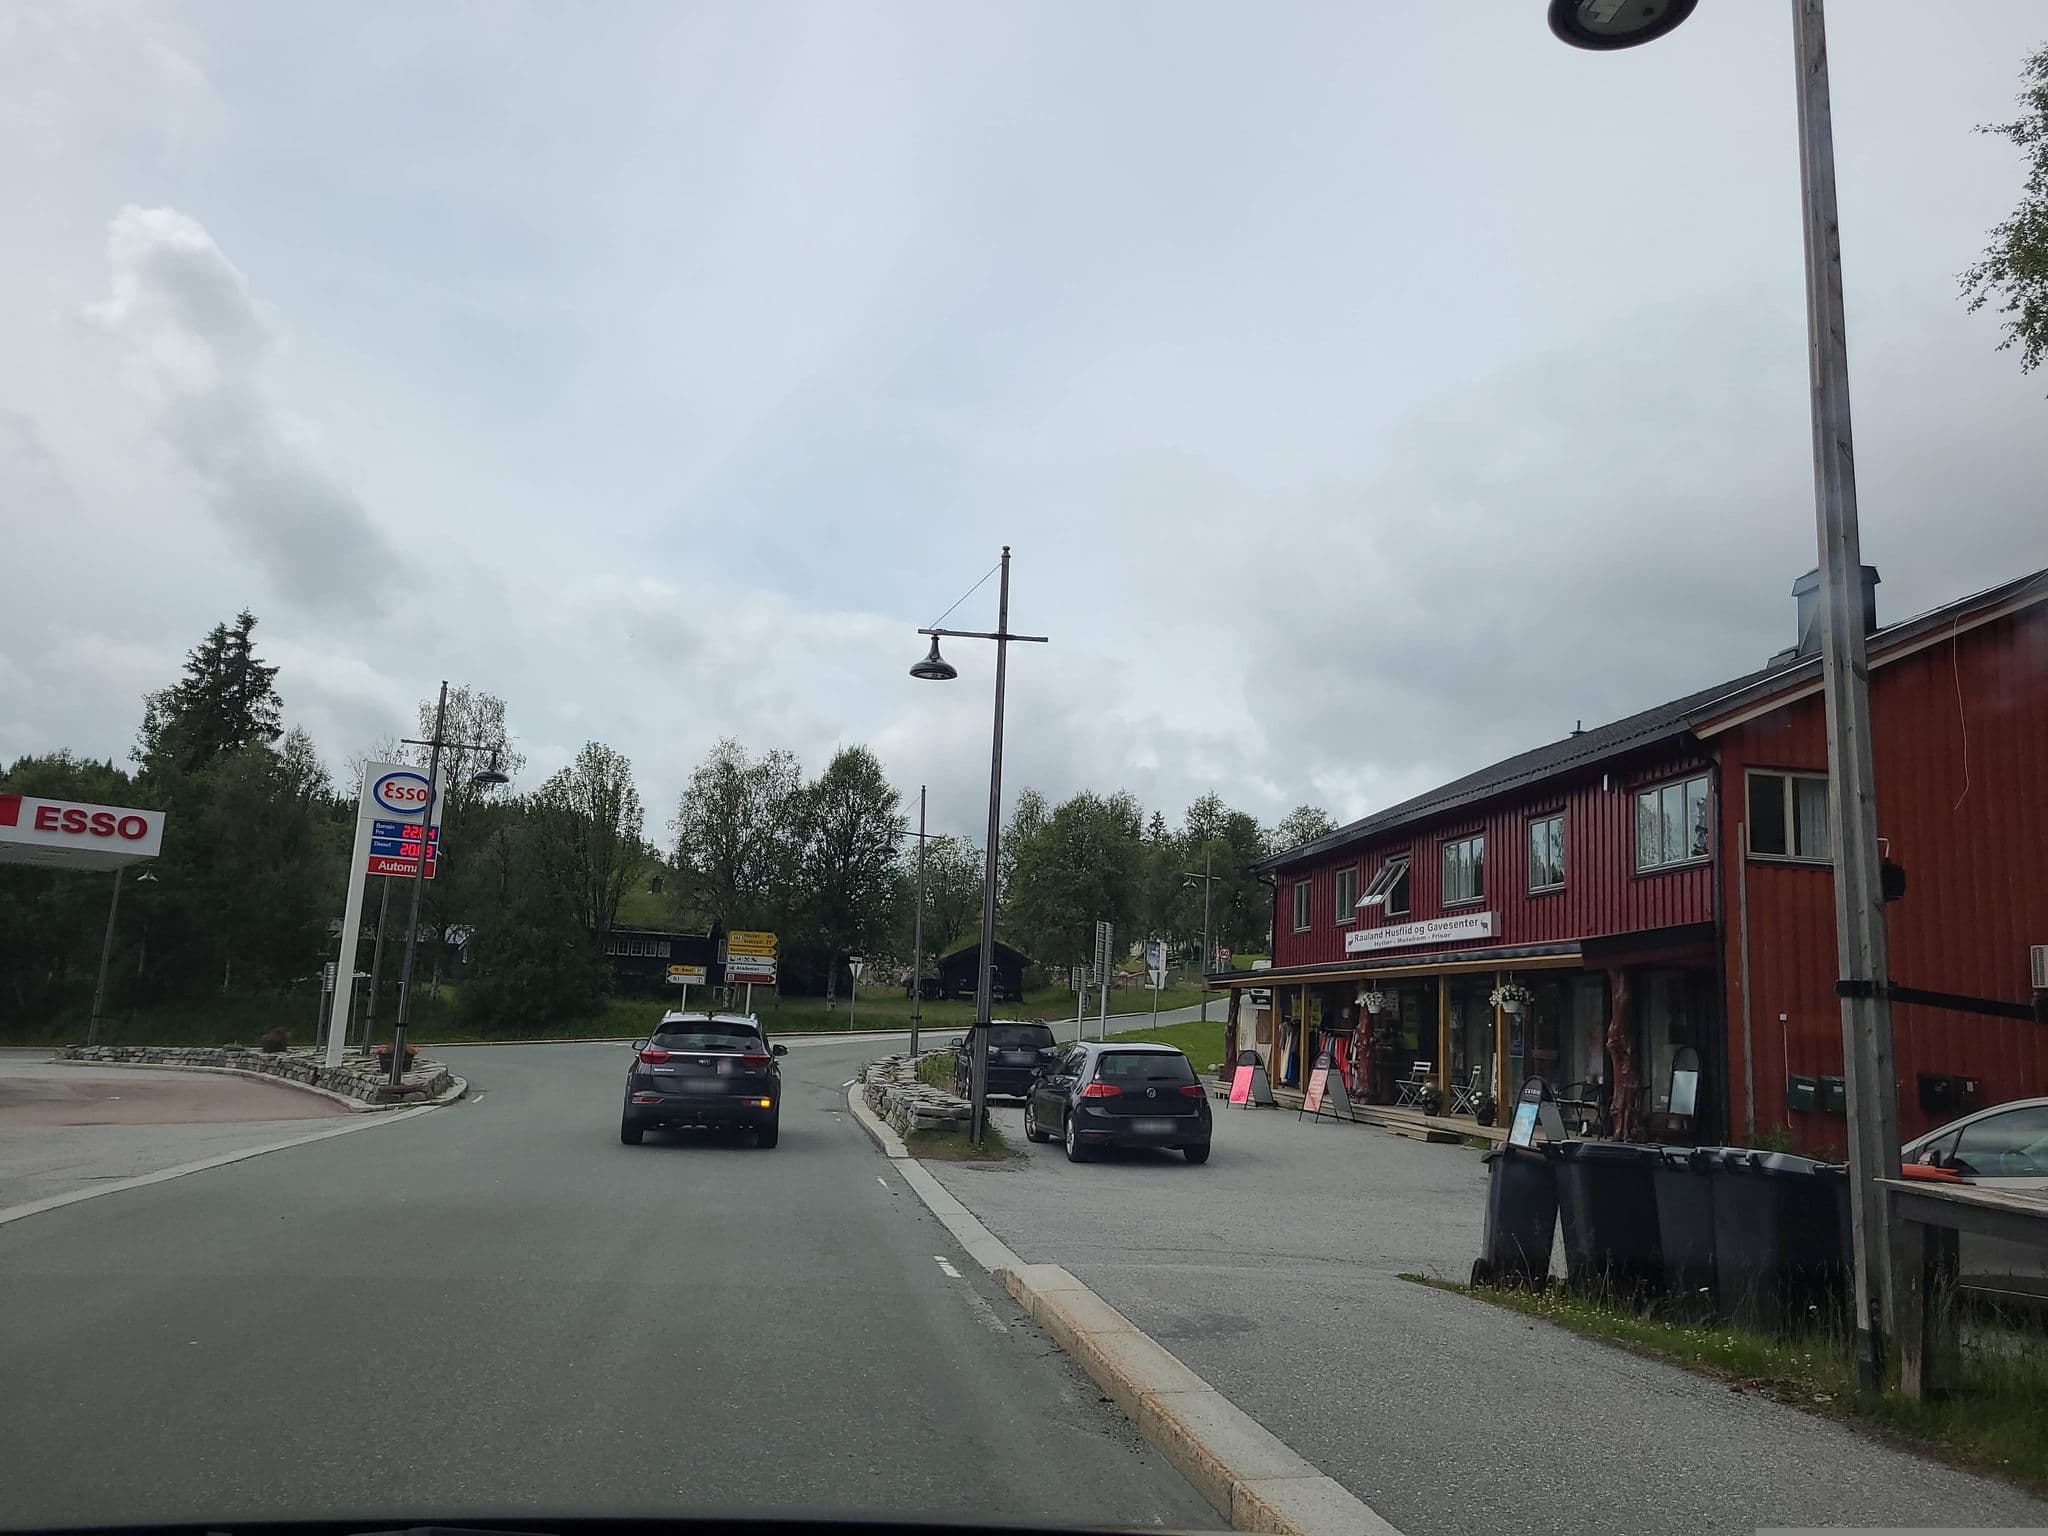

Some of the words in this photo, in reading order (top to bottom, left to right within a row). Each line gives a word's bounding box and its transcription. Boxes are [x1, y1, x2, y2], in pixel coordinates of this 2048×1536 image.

[384, 782, 428, 801] Esso
[34, 806, 148, 840] ESSO
[1354, 930, 1383, 942] Rauland
[1385, 925, 1413, 938] Husflid
[1414, 925, 1425, 935] og
[1427, 918, 1479, 932] Gavesenter
